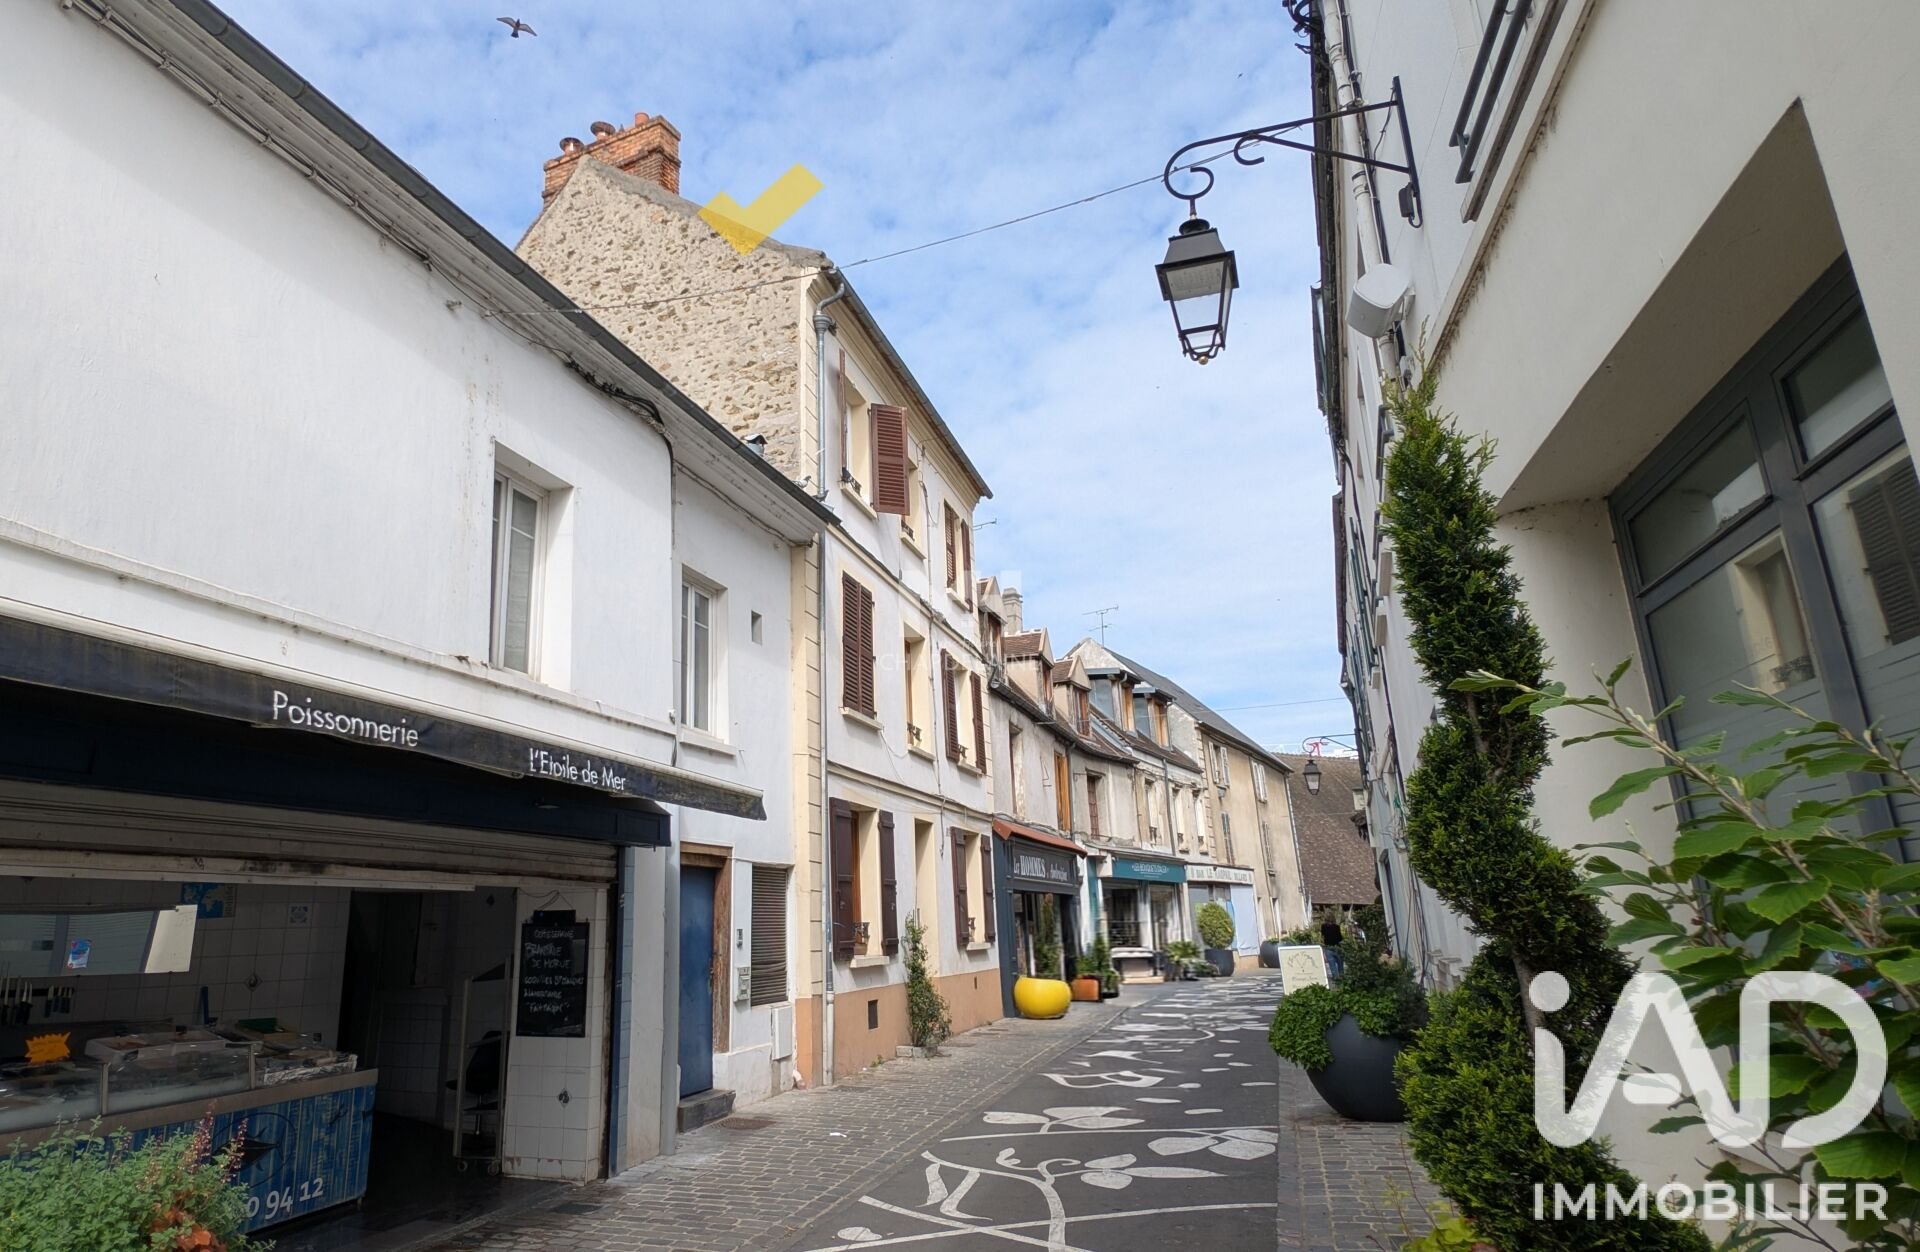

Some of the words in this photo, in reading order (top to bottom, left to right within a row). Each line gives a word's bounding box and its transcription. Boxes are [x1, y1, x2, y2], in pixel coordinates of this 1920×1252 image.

[273, 690, 419, 747] Poissonnerie
[529, 747, 578, 780] L'Etoile
[582, 760, 599, 784] de
[602, 766, 627, 790] Mer
[1020, 855, 1046, 878] HOMMES
[265, 1186, 293, 1219] 94
[299, 1177, 324, 1202] 12
